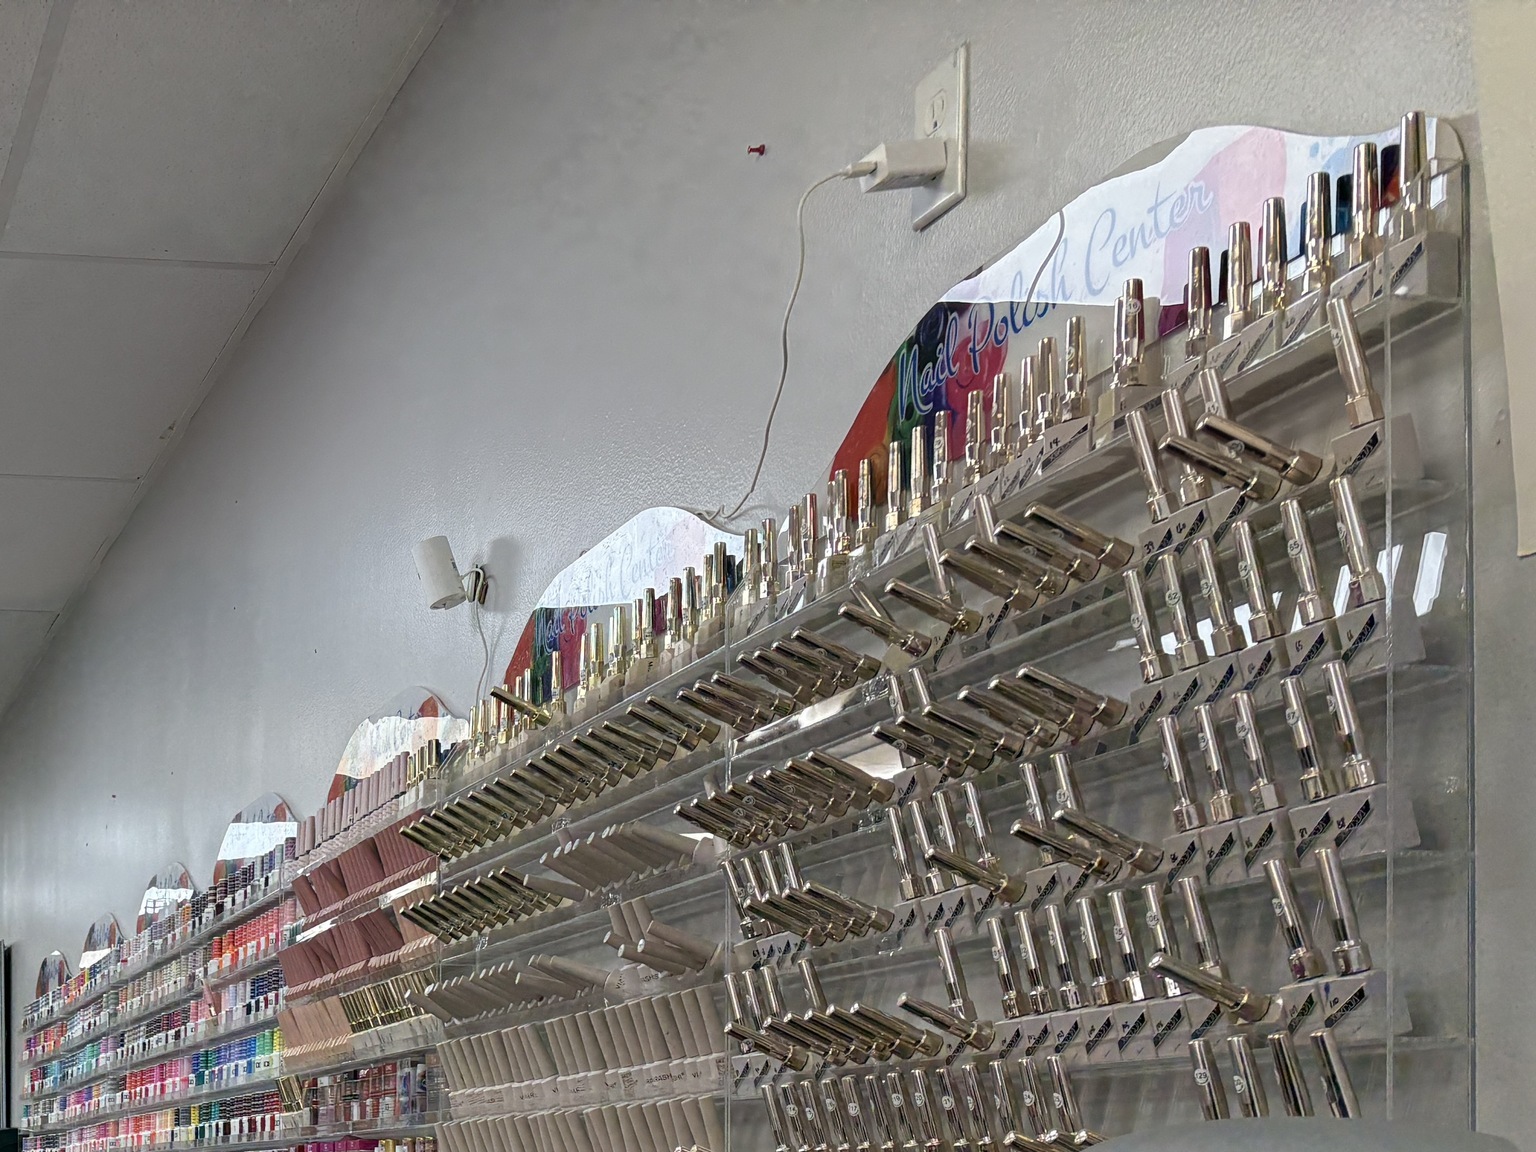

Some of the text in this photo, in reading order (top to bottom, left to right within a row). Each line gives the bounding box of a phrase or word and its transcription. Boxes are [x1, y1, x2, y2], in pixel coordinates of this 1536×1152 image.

[898, 180, 1214, 422] Nail Polish Center
